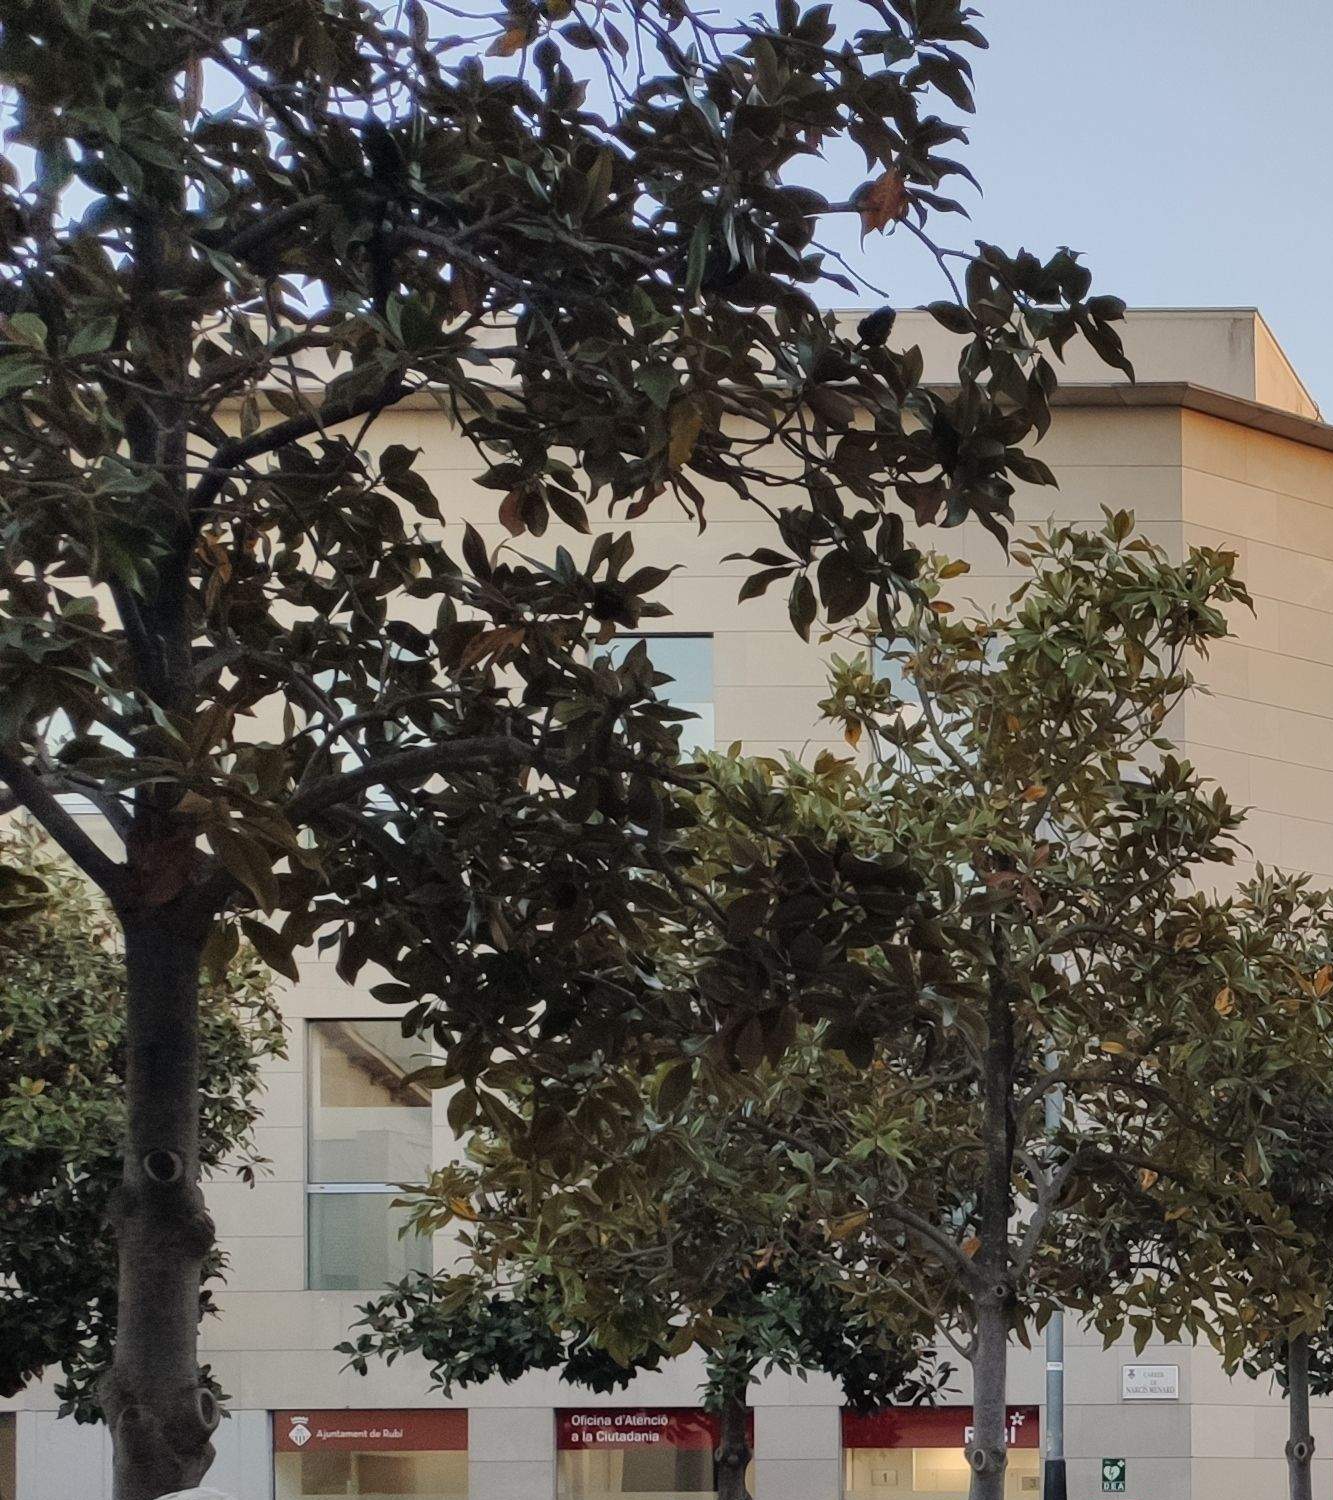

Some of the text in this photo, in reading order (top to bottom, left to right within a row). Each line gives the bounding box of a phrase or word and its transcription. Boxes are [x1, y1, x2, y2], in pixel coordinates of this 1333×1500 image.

[571, 1414, 669, 1426] Oficina d'Atenció
[316, 1429, 368, 1440] Ajuntament
[369, 1428, 381, 1438] de
[571, 1430, 660, 1442] a la Ciutadania
[1103, 1481, 1126, 1491] DEA
